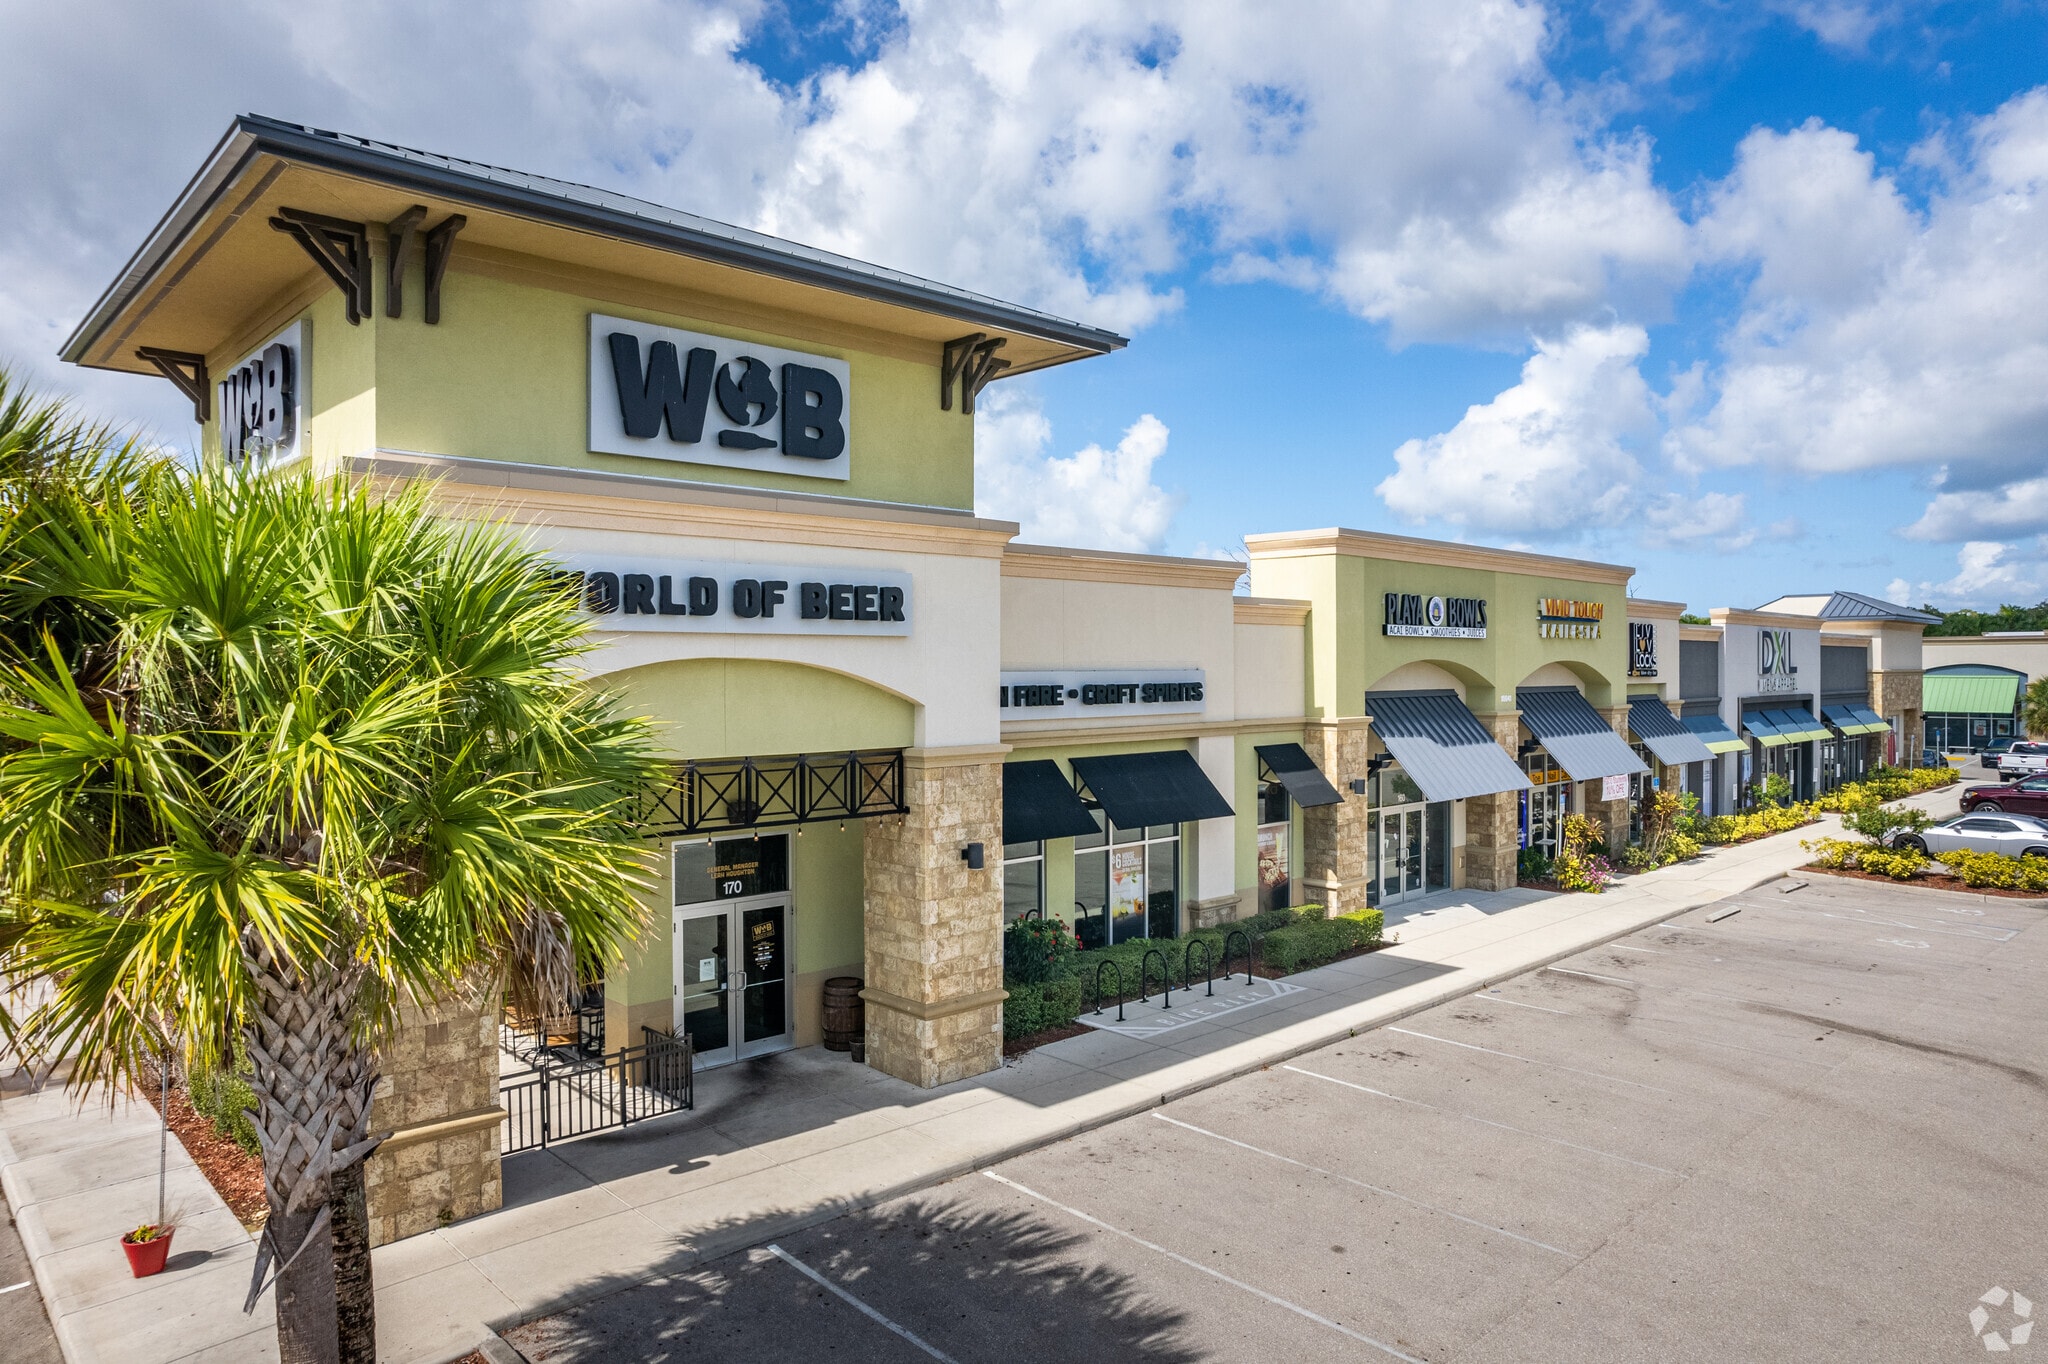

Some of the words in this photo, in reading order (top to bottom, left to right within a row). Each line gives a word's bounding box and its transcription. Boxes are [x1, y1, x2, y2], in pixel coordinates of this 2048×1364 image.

[733, 578, 788, 619] OF
[800, 582, 905, 622] BEER
[1385, 593, 1424, 625] PLAYA
[1446, 598, 1487, 628] BOWLS
[1405, 626, 1424, 635] BOWLS
[1430, 627, 1460, 637] SMOOTHIES
[1467, 628, 1485, 638] JUICES
[1758, 631, 1797, 675] DXL
[1014, 685, 1064, 707] FARE
[1082, 684, 1139, 705] CRAFT
[1142, 682, 1203, 704] SPIRITS
[732, 861, 759, 870] MANAGER
[723, 880, 742, 895] 170
[1155, 1007, 1212, 1026] BIKE
